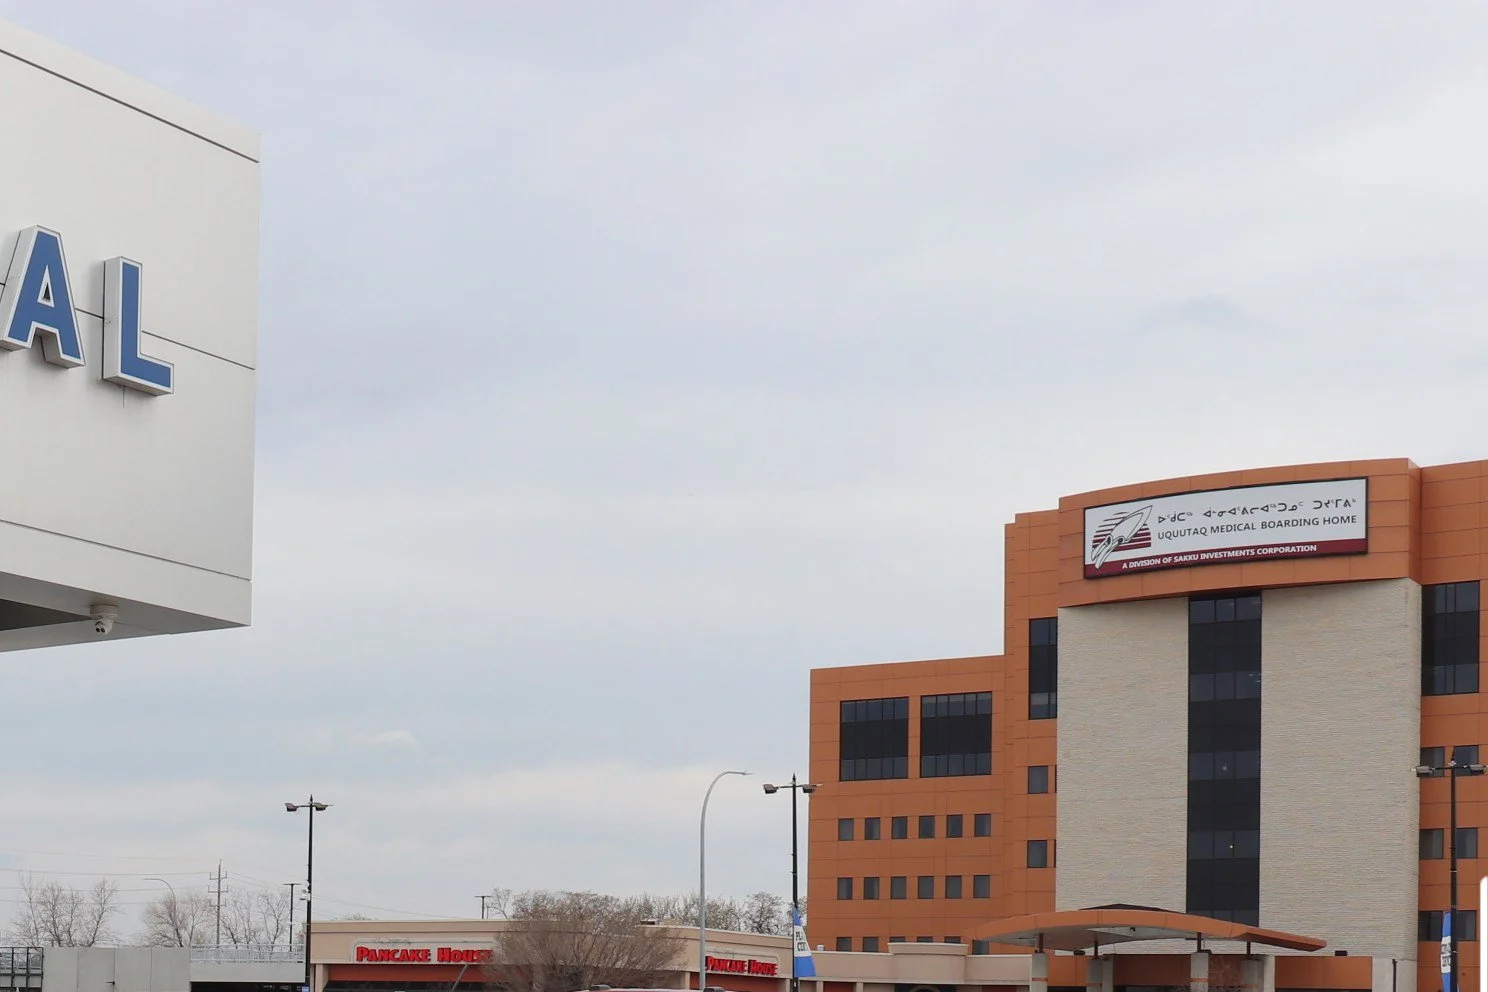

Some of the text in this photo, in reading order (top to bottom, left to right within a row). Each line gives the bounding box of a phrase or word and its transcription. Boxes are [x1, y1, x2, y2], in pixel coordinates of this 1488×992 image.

[1158, 515, 1357, 540] UQUUTAQ MEDICAL BOARDING HOME
[1129, 558, 1161, 568] DIVISION
[1162, 557, 1172, 565] OF
[1173, 553, 1199, 563] SAKKU
[1200, 548, 1255, 560] INVESTMENTS
[1256, 544, 1317, 555] CORPORATION
[356, 946, 431, 962] PANCAKE
[705, 956, 777, 976] PANCAKE HOUSE
